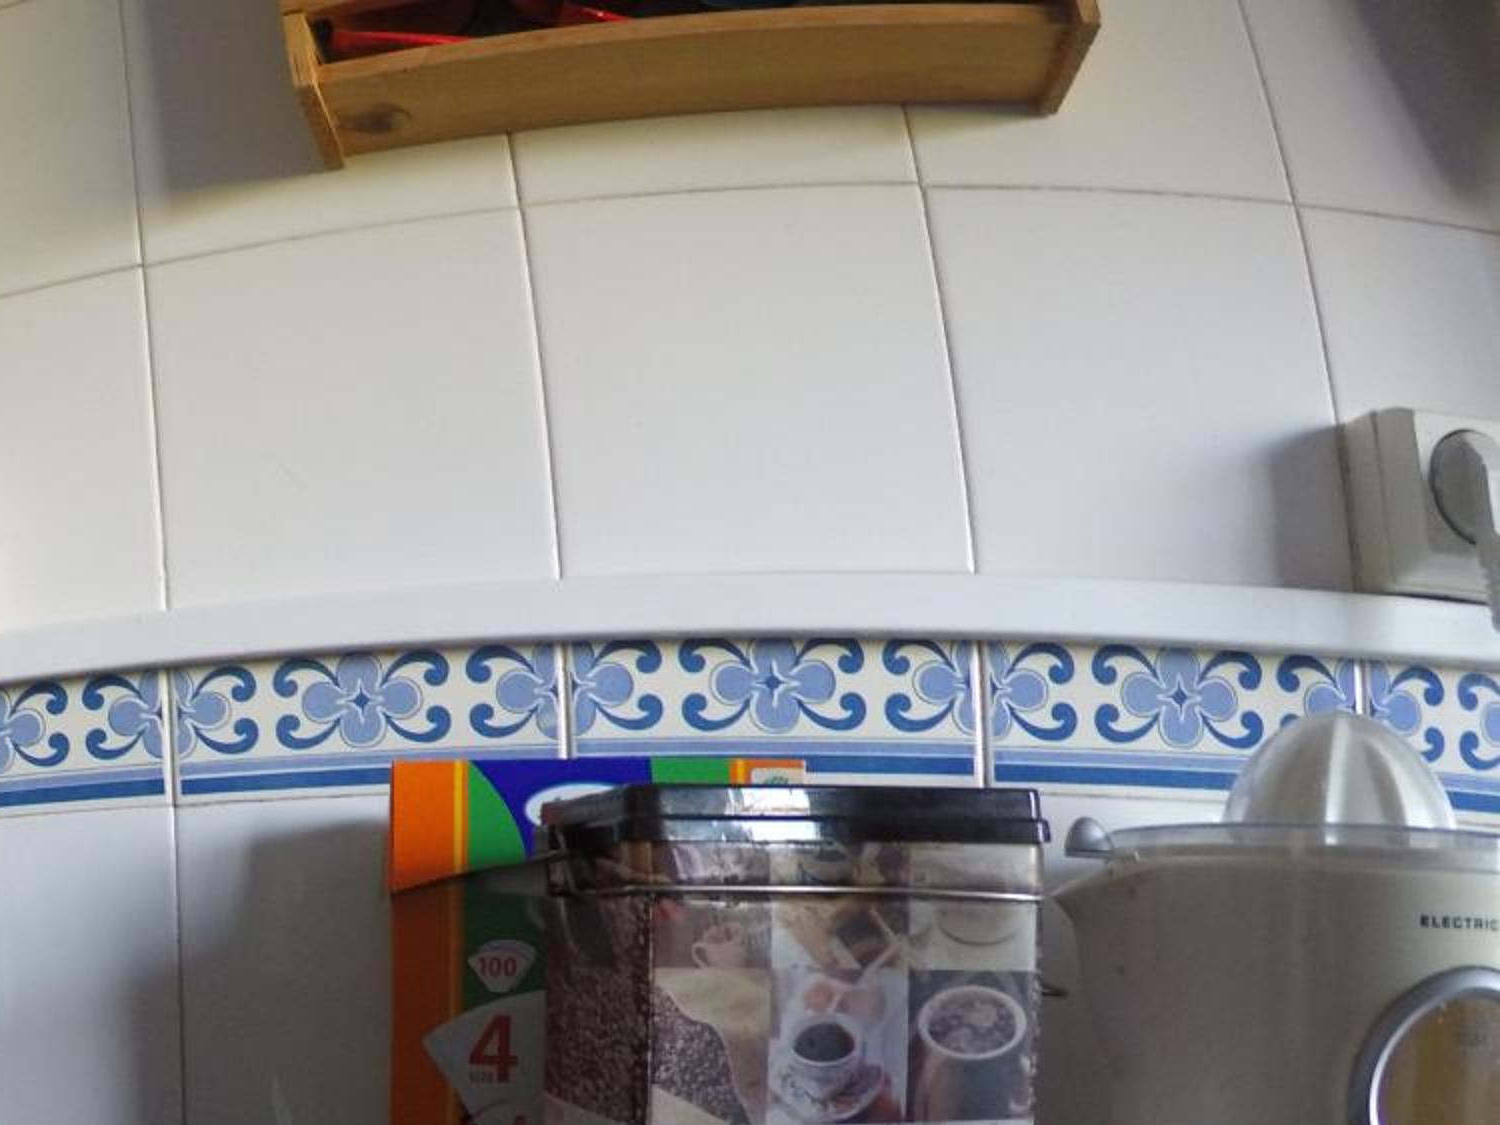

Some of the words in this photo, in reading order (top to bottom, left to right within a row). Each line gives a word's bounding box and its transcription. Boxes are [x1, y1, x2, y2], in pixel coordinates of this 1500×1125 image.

[1420, 913, 1499, 931] ELECTRIC
[478, 956, 518, 978] 100
[468, 1013, 518, 1084] 4
